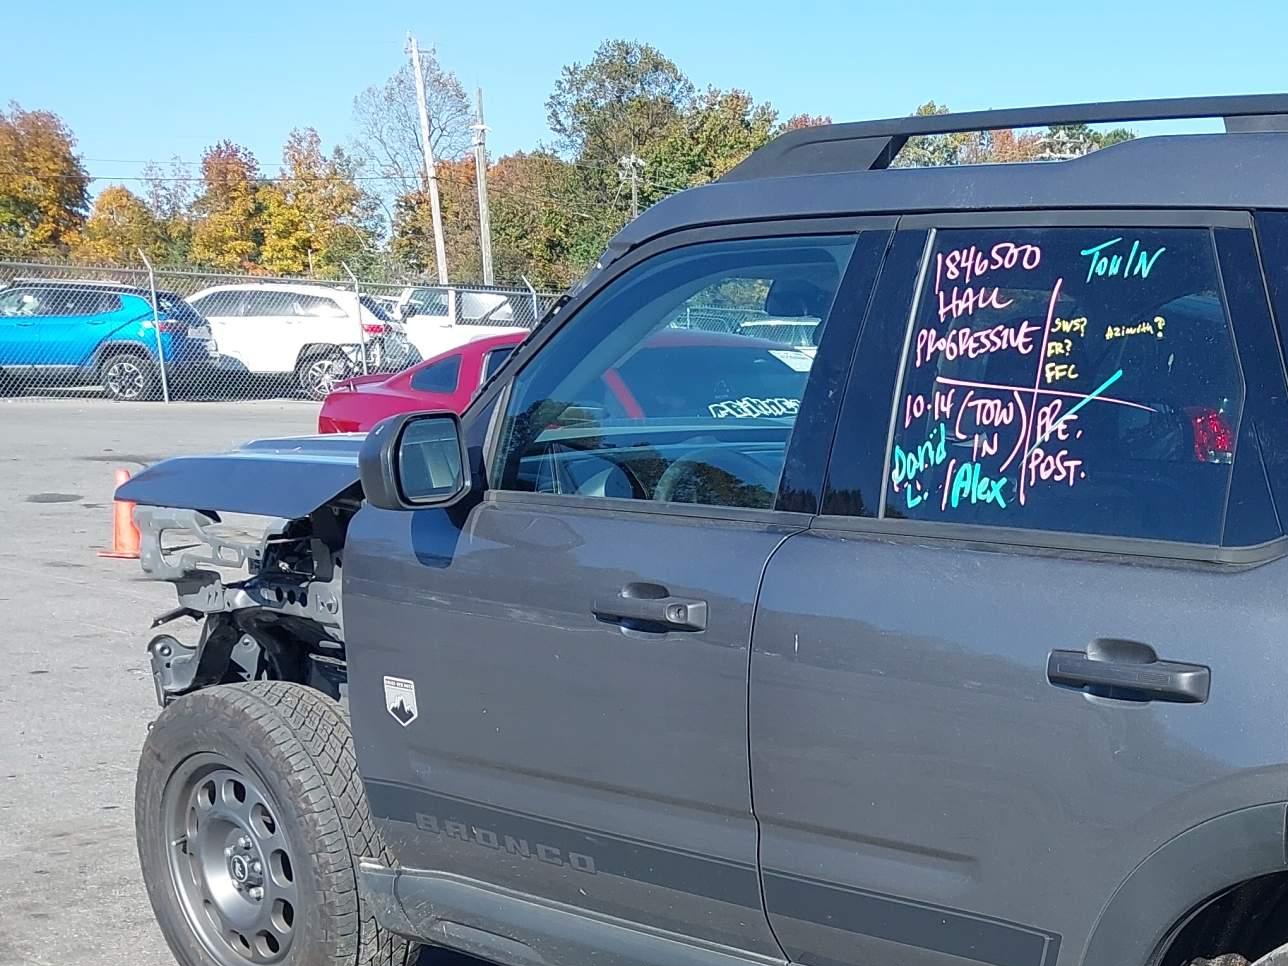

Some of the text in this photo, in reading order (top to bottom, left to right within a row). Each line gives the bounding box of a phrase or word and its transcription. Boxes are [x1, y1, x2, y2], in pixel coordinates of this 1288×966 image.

[936, 242, 1041, 294] 1846500
[938, 287, 1014, 322] HALL
[916, 320, 1042, 367] PROGRESSIVE
[1045, 362, 1079, 384] FFC
[415, 812, 598, 875] BRONCO
